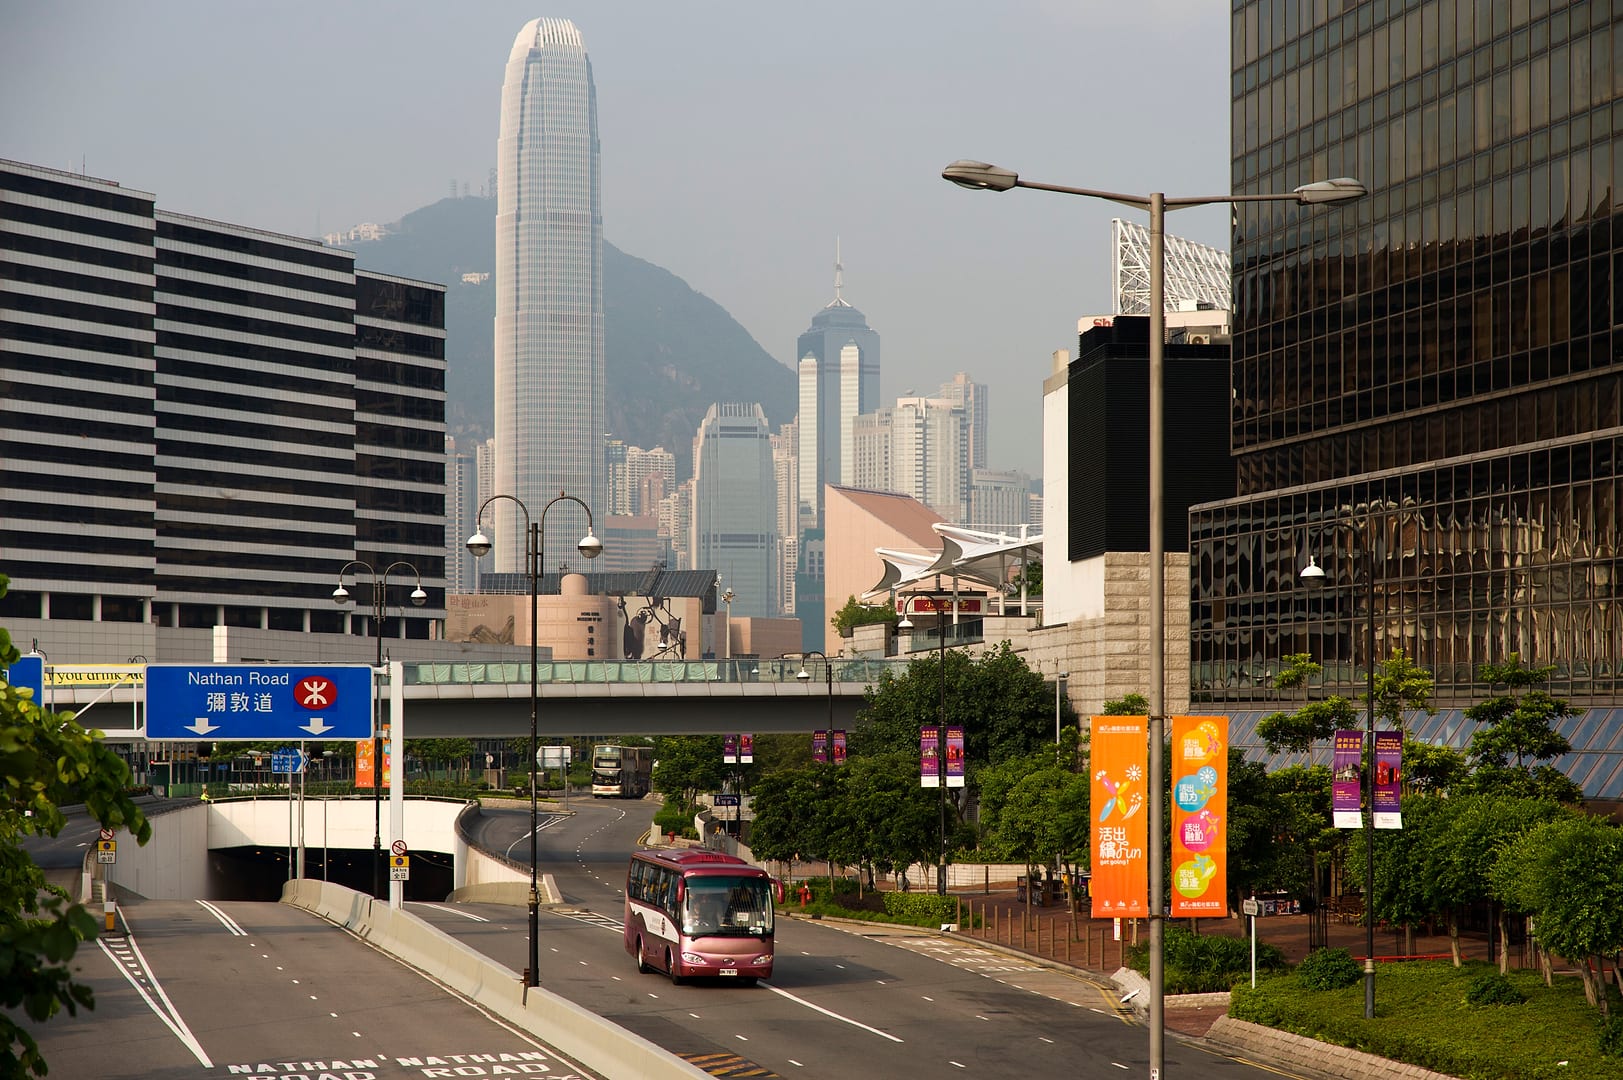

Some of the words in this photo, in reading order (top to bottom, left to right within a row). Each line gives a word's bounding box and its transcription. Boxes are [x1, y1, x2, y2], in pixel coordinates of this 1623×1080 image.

[188, 671, 243, 686] Nathan
[249, 671, 289, 686] Road
[206, 692, 273, 713] 彌敦道
[1099, 826, 1126, 841] 活出
[227, 1059, 380, 1074] NATHAN
[396, 1051, 548, 1067] NATHAN
[421, 1063, 551, 1078] ROAD
